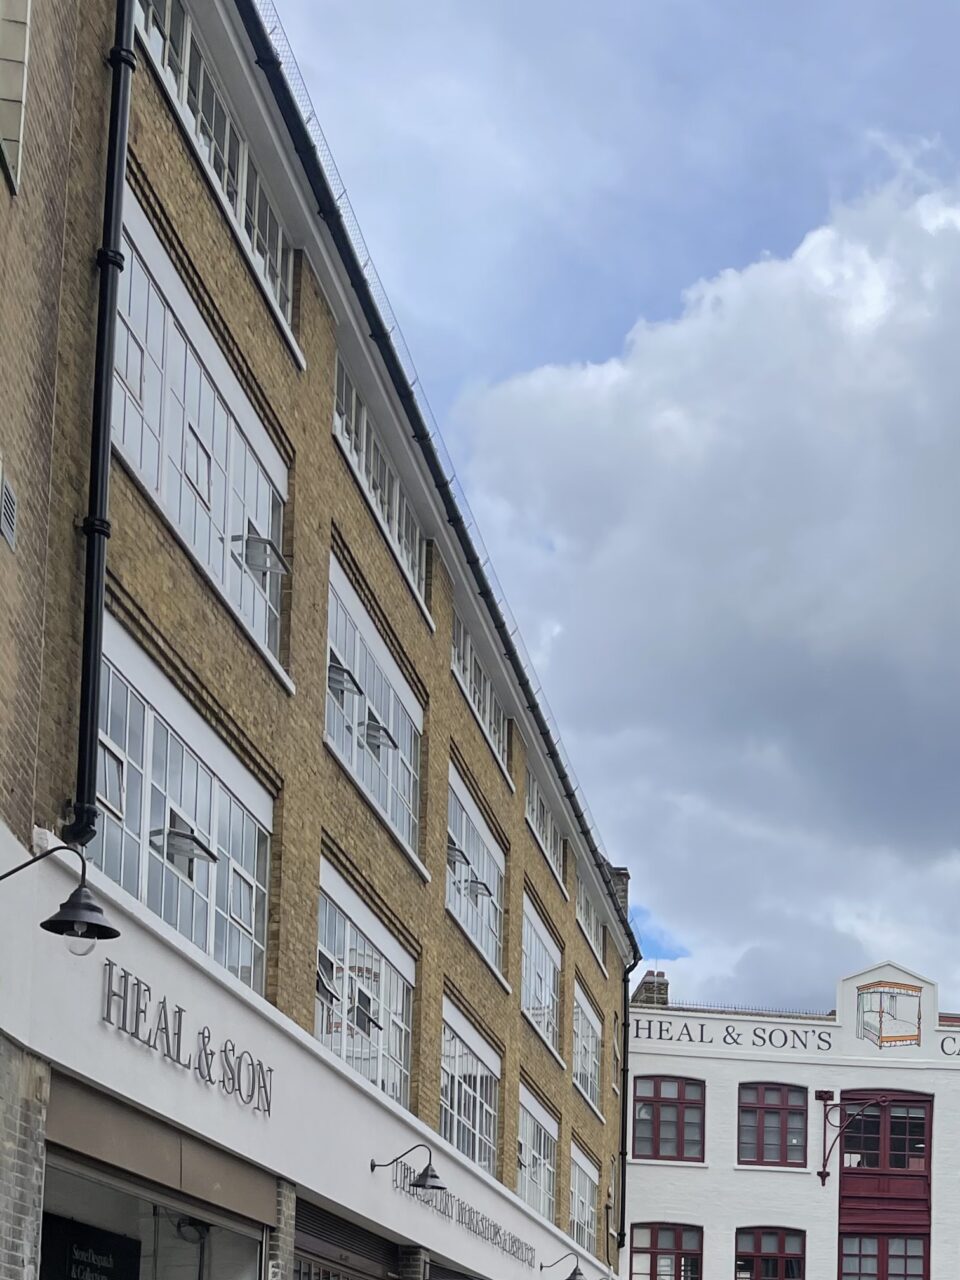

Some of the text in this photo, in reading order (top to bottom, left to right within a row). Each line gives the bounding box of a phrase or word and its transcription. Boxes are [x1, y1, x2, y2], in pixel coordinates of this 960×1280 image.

[102, 957, 275, 1118] HEAL & SON
[633, 1019, 832, 1051] HEAL & SON'S
[456, 1198, 502, 1248] WORKSHOPS
[508, 1231, 536, 1268] DESPATCH
